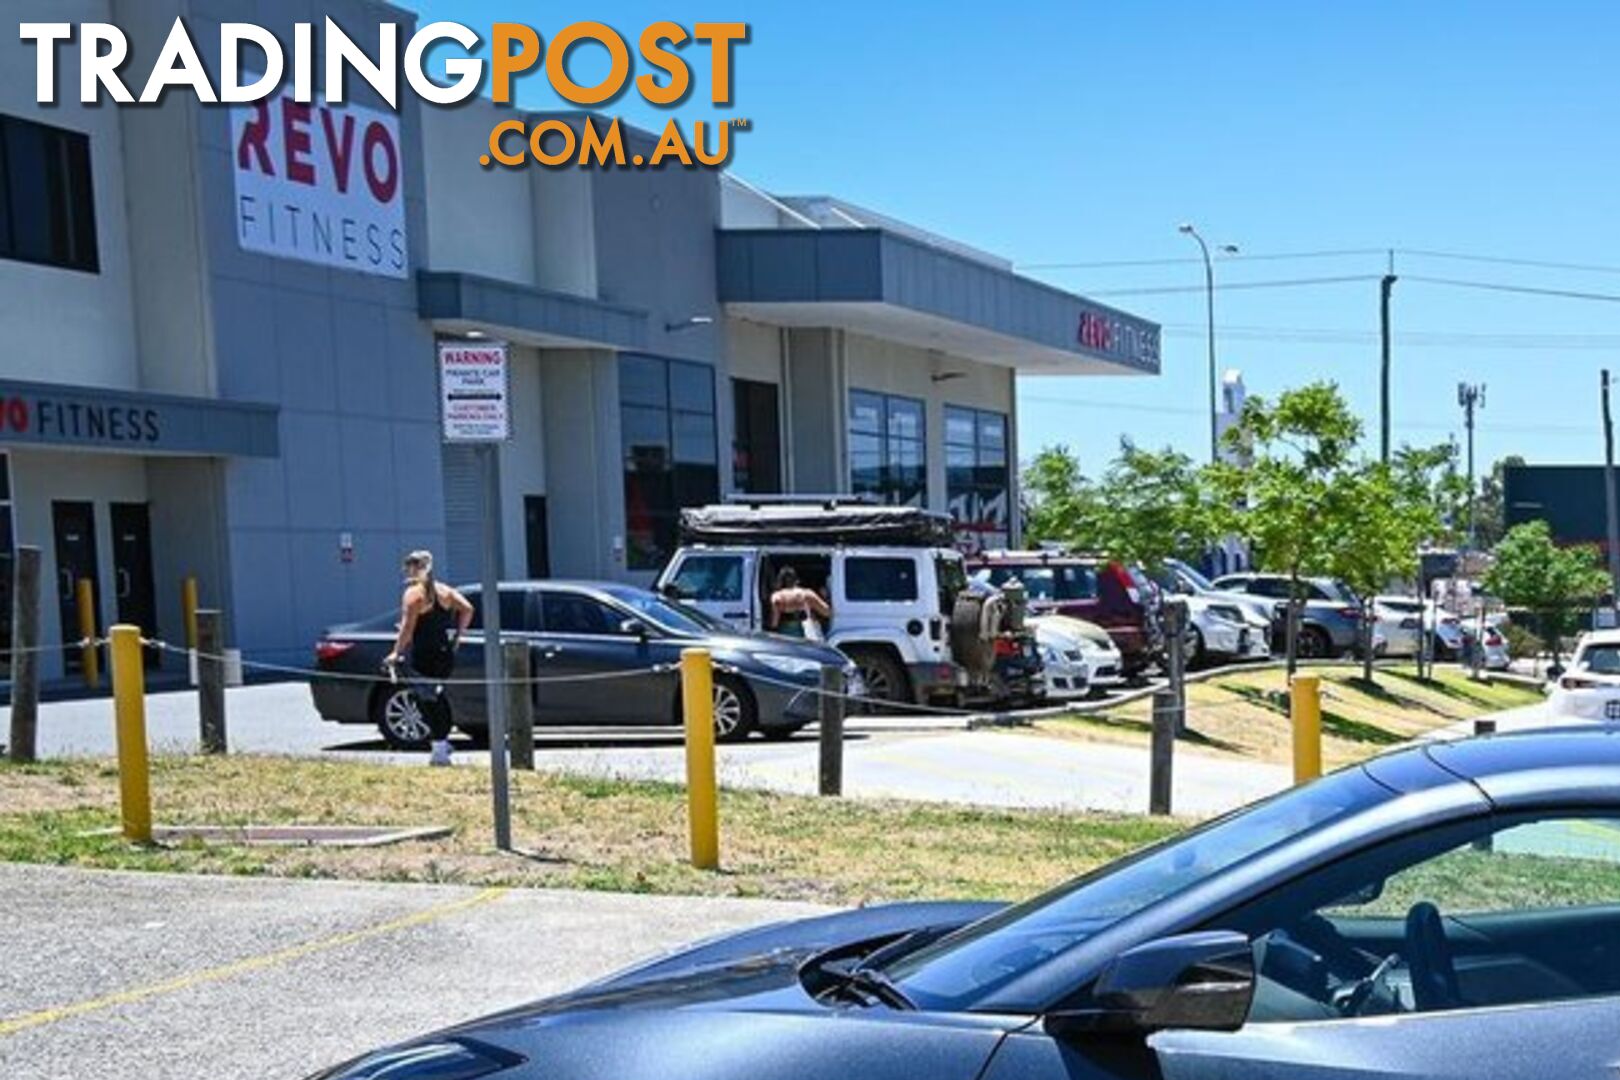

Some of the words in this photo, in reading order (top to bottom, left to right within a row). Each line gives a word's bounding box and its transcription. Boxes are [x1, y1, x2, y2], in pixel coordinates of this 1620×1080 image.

[237, 96, 398, 203] REVO
[240, 195, 402, 270] FITNESS
[445, 351, 502, 365] WARNING
[37, 401, 160, 442] FITNESS
